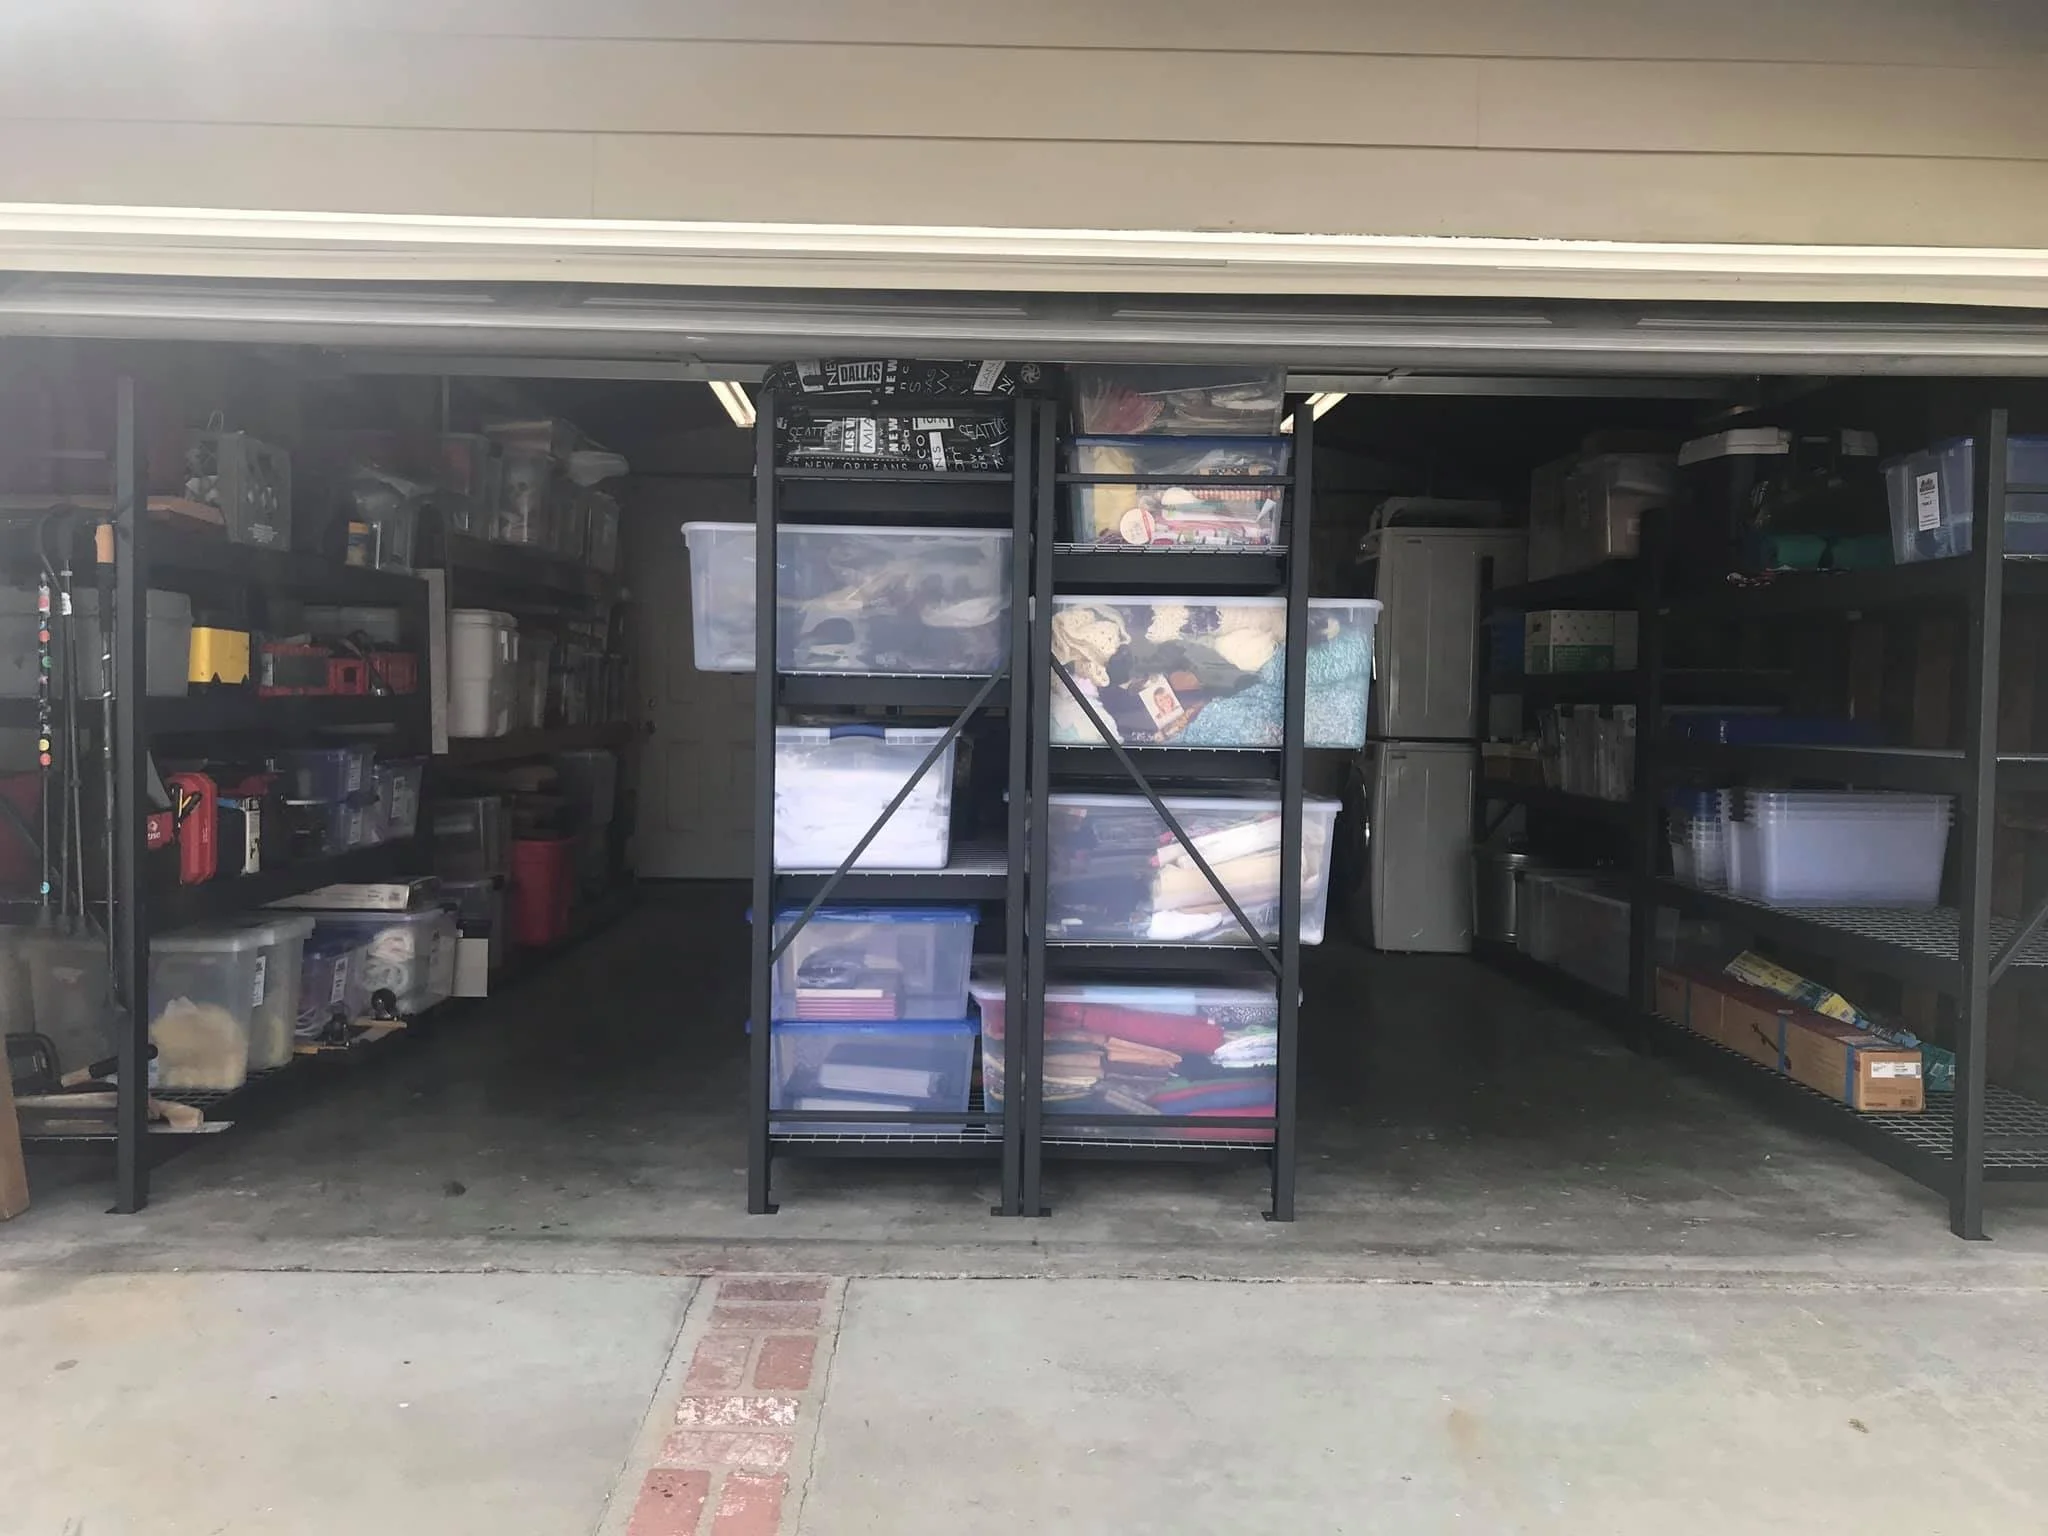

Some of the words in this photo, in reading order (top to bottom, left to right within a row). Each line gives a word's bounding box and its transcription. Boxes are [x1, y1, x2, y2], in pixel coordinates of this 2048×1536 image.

[840, 363, 881, 383] DALLAS
[885, 358, 898, 395] NEW
[888, 417, 900, 452] NEW
[958, 417, 1009, 440] SEATTLE
[804, 460, 834, 471] NEW
